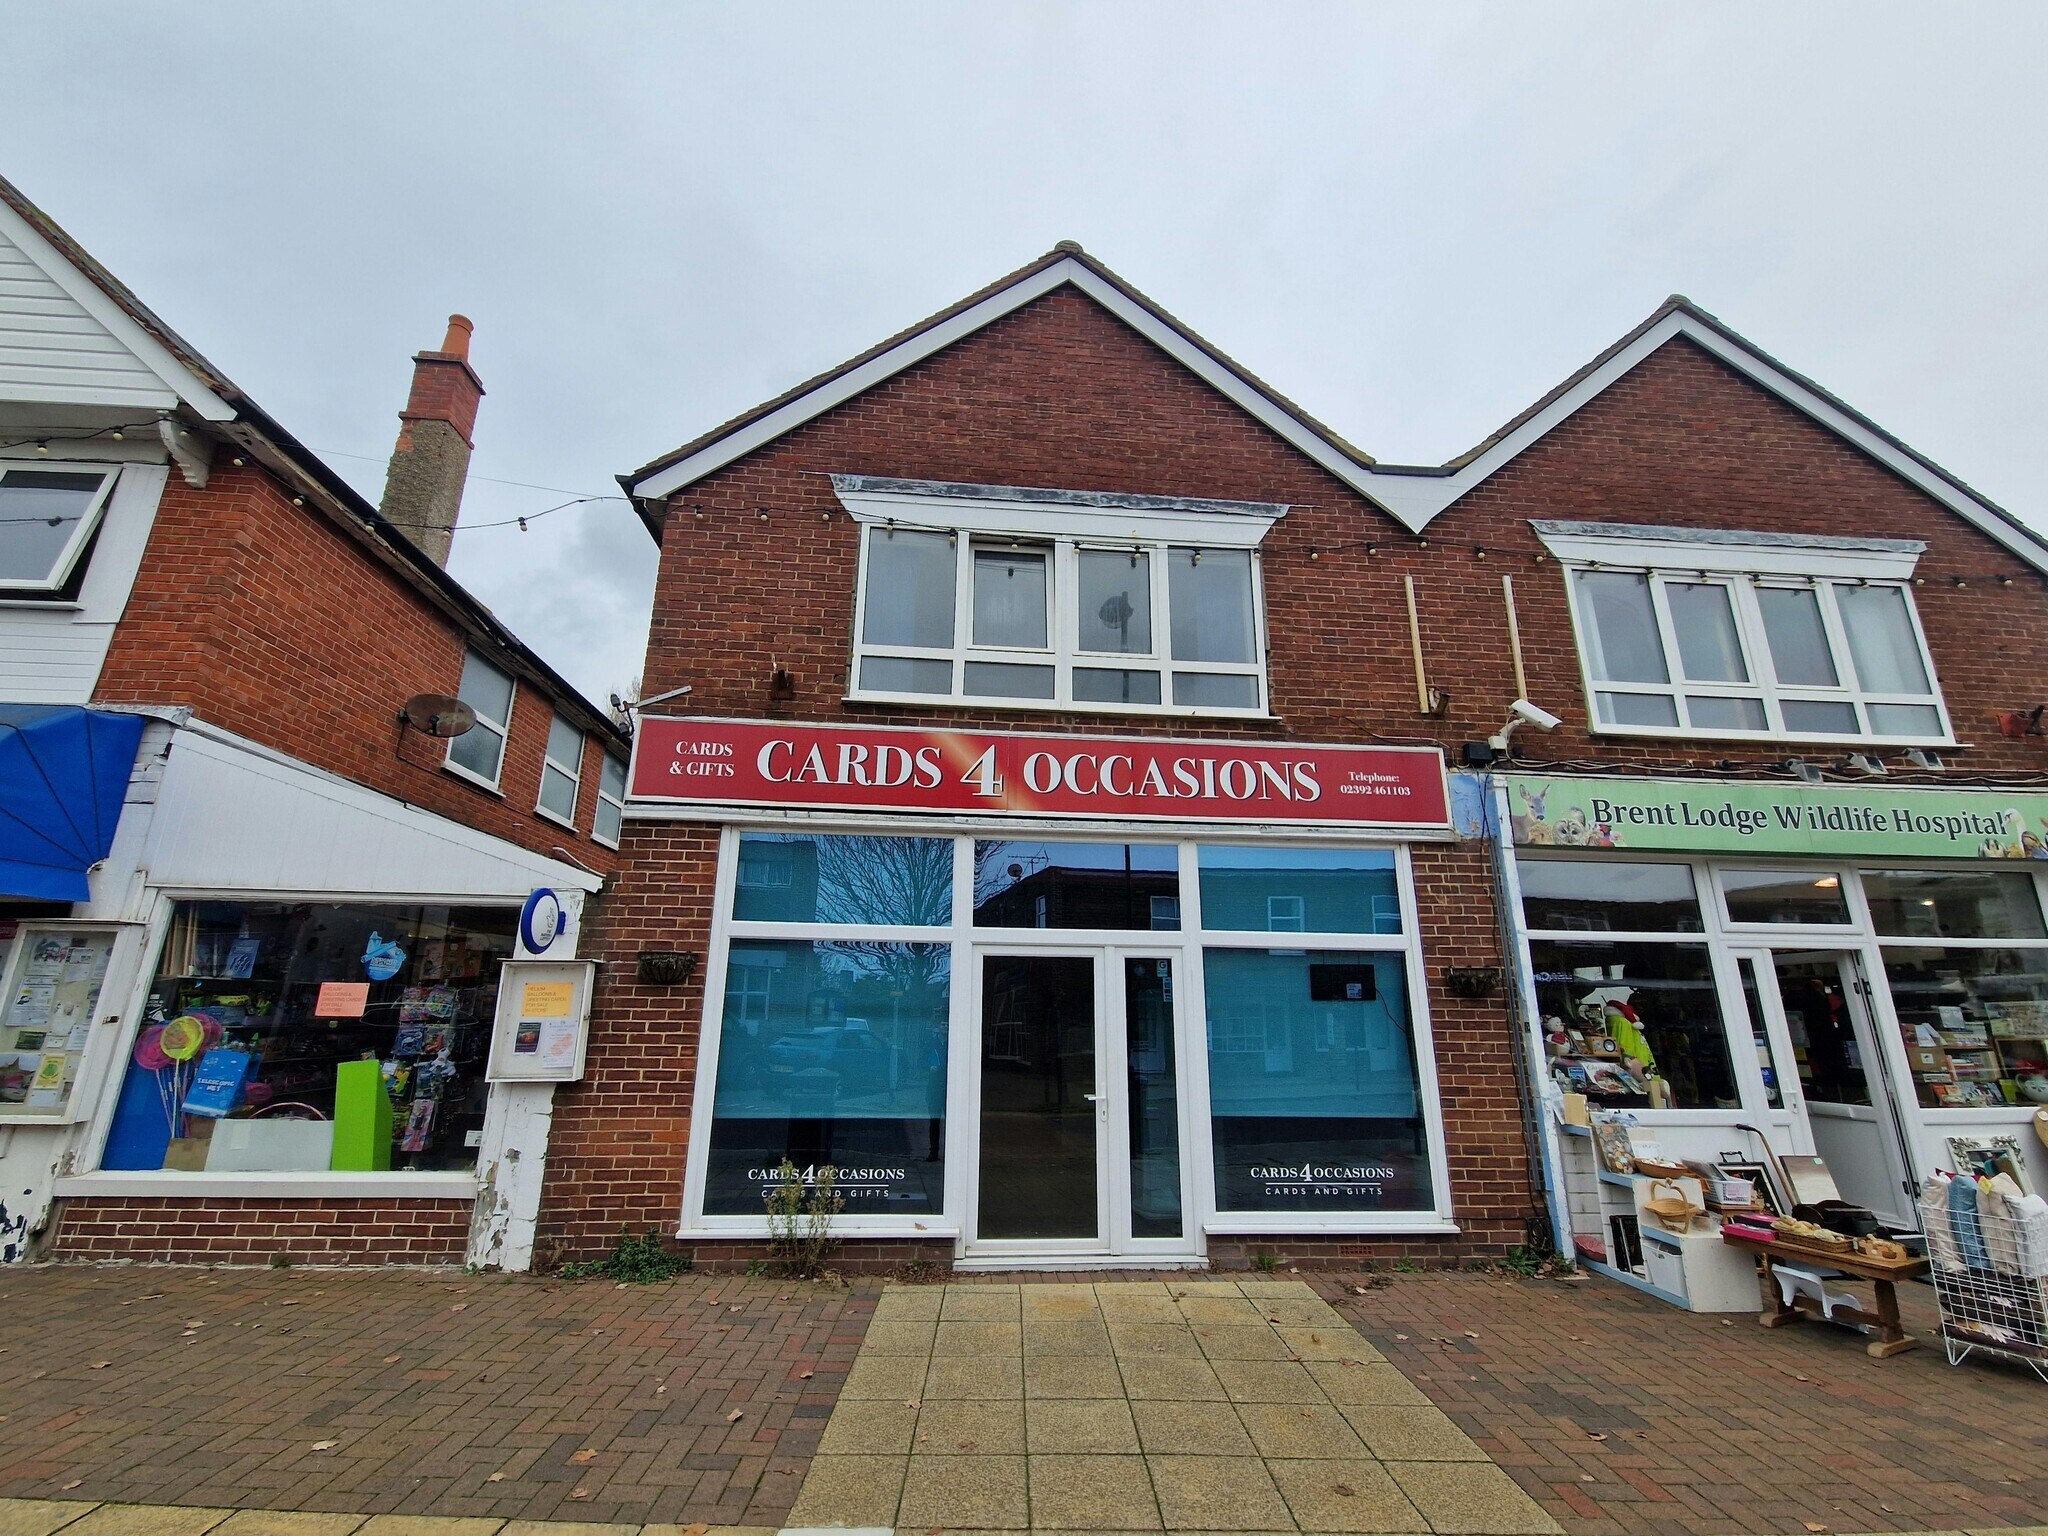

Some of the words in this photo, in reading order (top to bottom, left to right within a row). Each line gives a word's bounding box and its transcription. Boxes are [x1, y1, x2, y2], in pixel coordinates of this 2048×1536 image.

[676, 741, 733, 757] CARDS
[669, 761, 684, 775] &
[686, 762, 735, 777] GIFTS
[757, 740, 943, 789] CARDS
[959, 743, 1004, 797] 4
[1023, 752, 1321, 801] OCCASIONS
[1348, 771, 1400, 784] Telephone:
[1340, 785, 1373, 795] 02392
[1373, 785, 1411, 796] 461103
[1591, 798, 1676, 826] Brent
[1683, 803, 1768, 835] Lodge
[1773, 805, 1887, 832] Wildlife
[1891, 809, 2007, 840] Hospital
[850, 1190, 889, 1198] GIFTS
